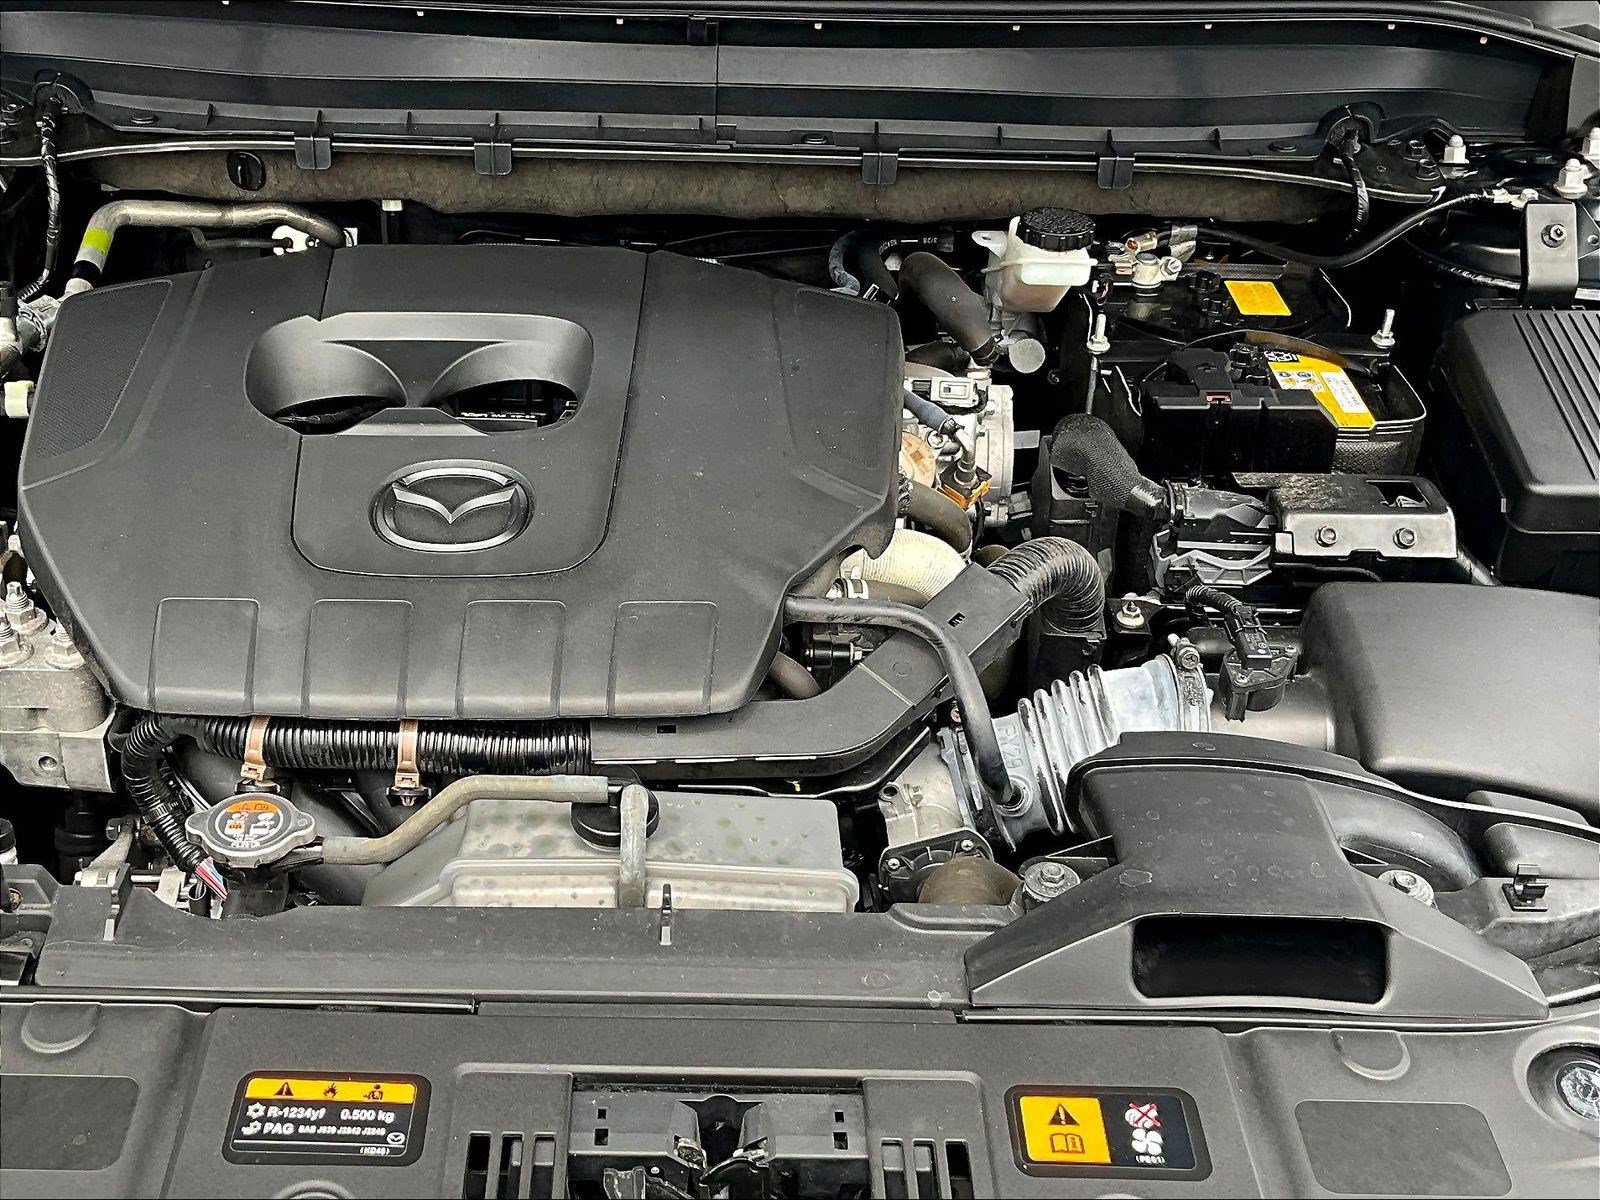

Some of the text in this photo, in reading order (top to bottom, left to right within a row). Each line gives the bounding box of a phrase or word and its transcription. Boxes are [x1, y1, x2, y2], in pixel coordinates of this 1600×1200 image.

[266, 1105, 396, 1124] R-1234yf 0.500 kg
[262, 1122, 295, 1135] PAG
